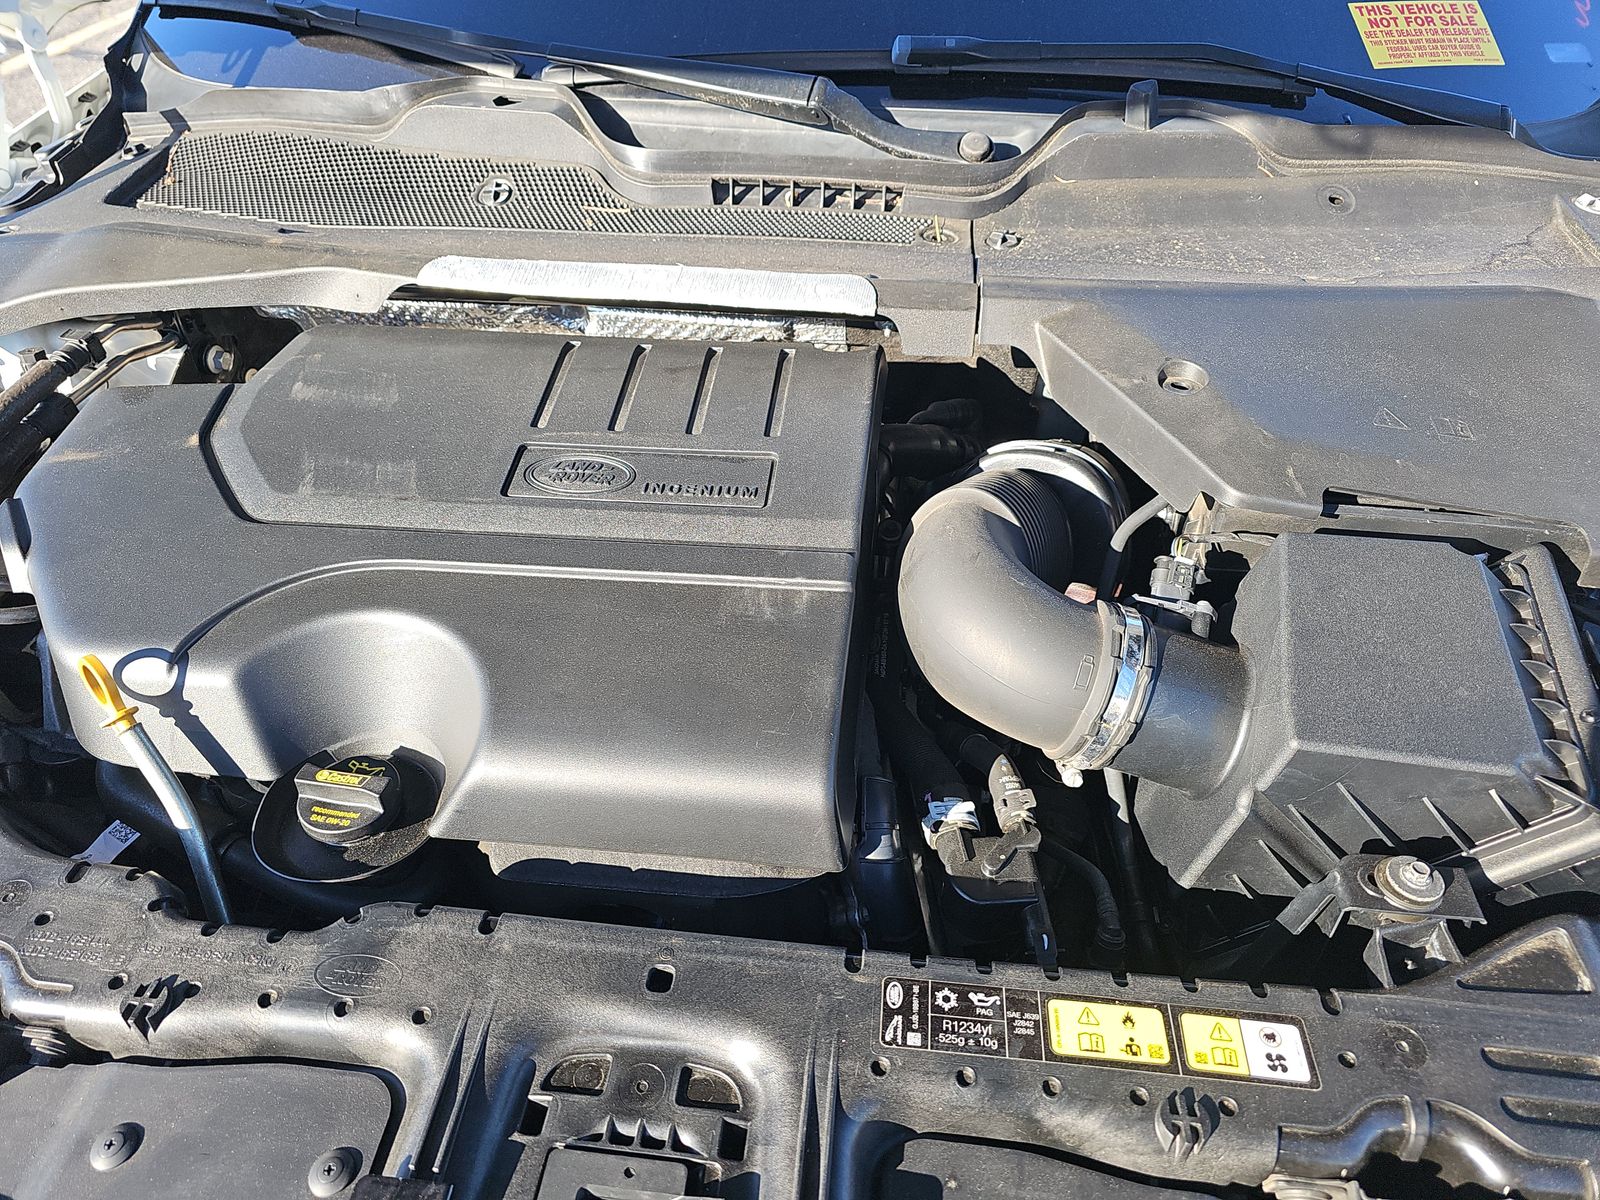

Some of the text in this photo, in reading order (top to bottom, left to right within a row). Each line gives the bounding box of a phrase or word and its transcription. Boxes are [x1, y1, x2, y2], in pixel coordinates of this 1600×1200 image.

[1355, 3, 1478, 17] THIS VEHICLE IS
[1367, 15, 1478, 29] NOT FOR SALE
[1364, 28, 1490, 39] SEE THE DEALER FOR RELEASE DATE
[549, 459, 606, 472] LAND
[552, 471, 616, 486] ROVER
[642, 481, 760, 499] INGENIUM
[328, 771, 363, 785] Castrol
[311, 805, 361, 819] recommended
[310, 814, 351, 827] SAE 0W-20
[976, 1007, 994, 1017] PAG
[1006, 1010, 1040, 1021] SAE J639
[942, 1019, 993, 1038] R1234yf
[1012, 1019, 1035, 1028] J2842
[1013, 1027, 1036, 1036] J2845
[967, 1038, 976, 1046] ±
[979, 1037, 999, 1050] 10g
